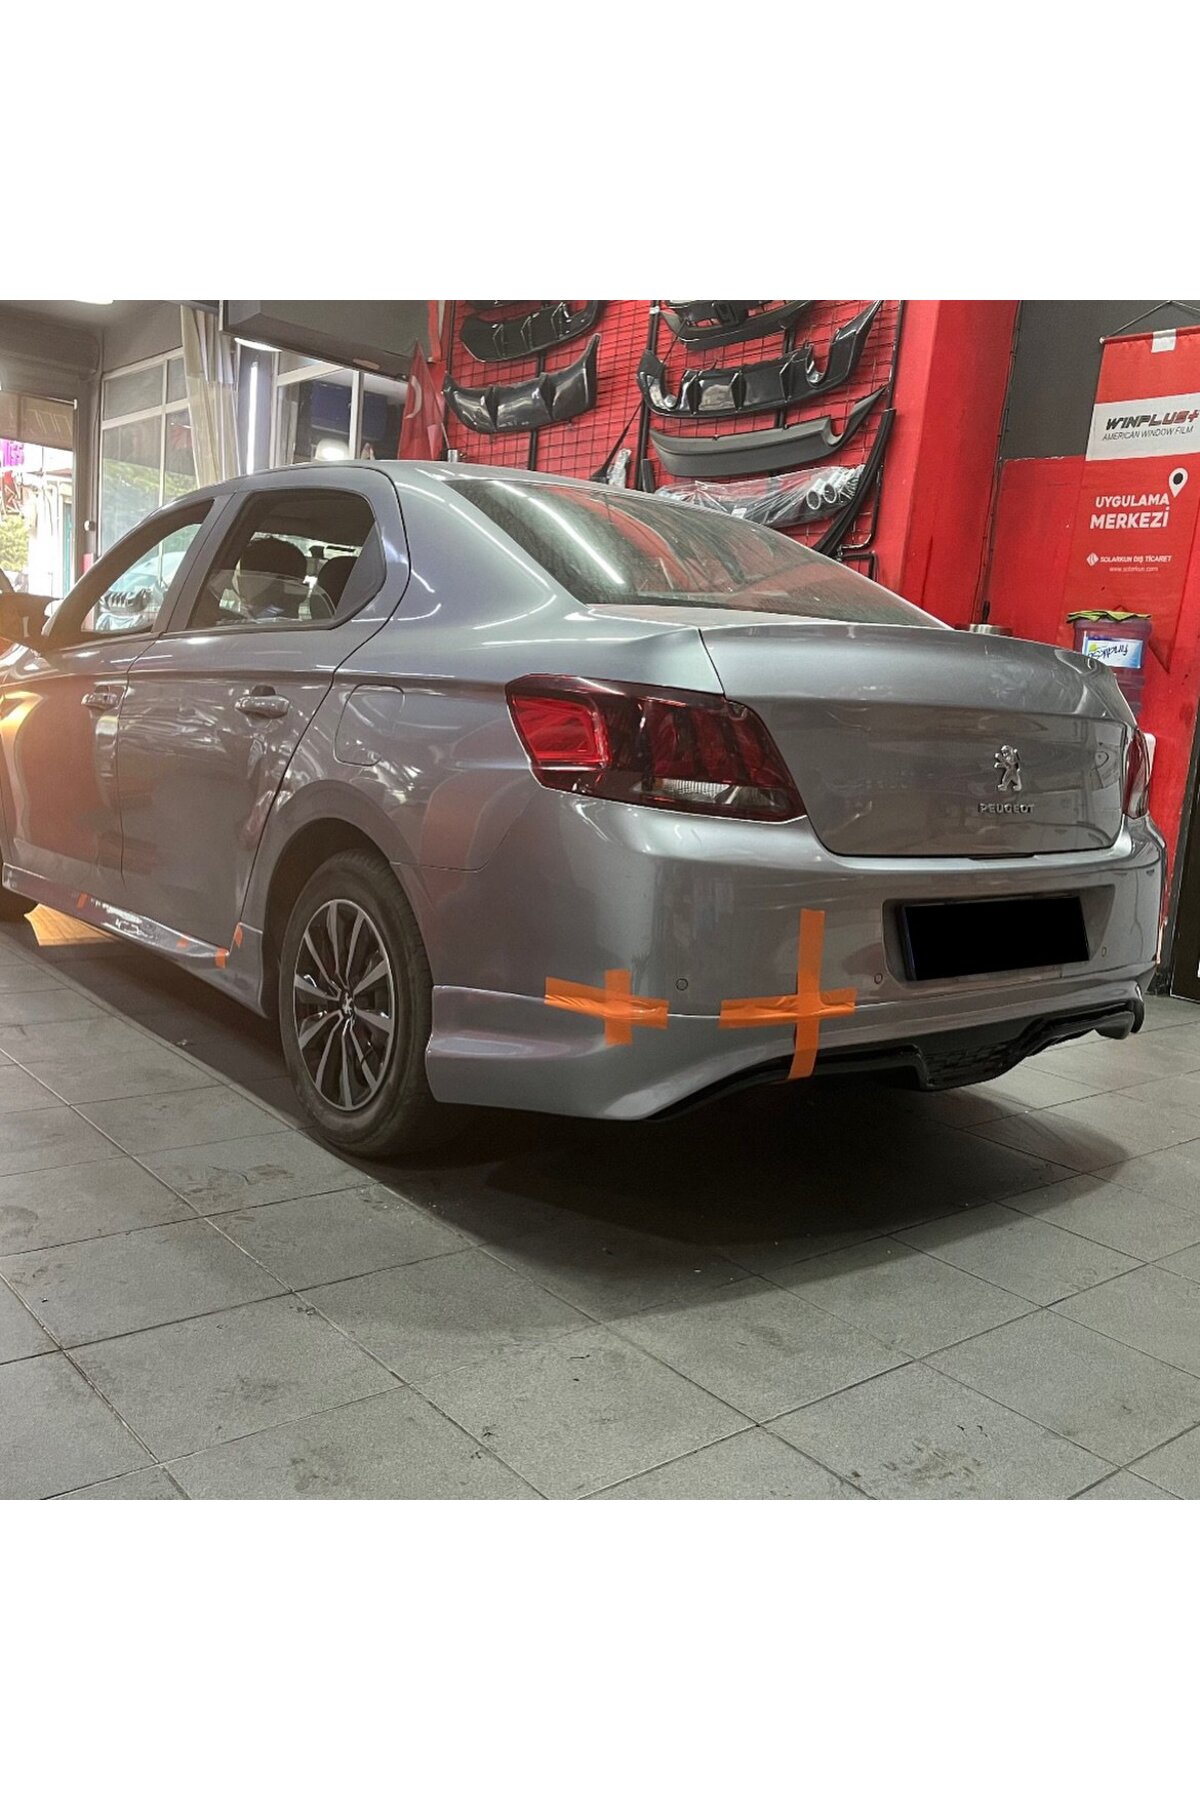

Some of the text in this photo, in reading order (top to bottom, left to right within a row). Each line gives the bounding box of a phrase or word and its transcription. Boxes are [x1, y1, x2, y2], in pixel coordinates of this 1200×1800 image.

[1102, 425, 1194, 441] AMERICAN WINDOW FILM
[1095, 493, 1170, 508] UYGULAMA
[1089, 506, 1170, 530] MERKEZİ
[1145, 554, 1172, 563] TİCARET
[978, 803, 1035, 814] PEUGEOT
